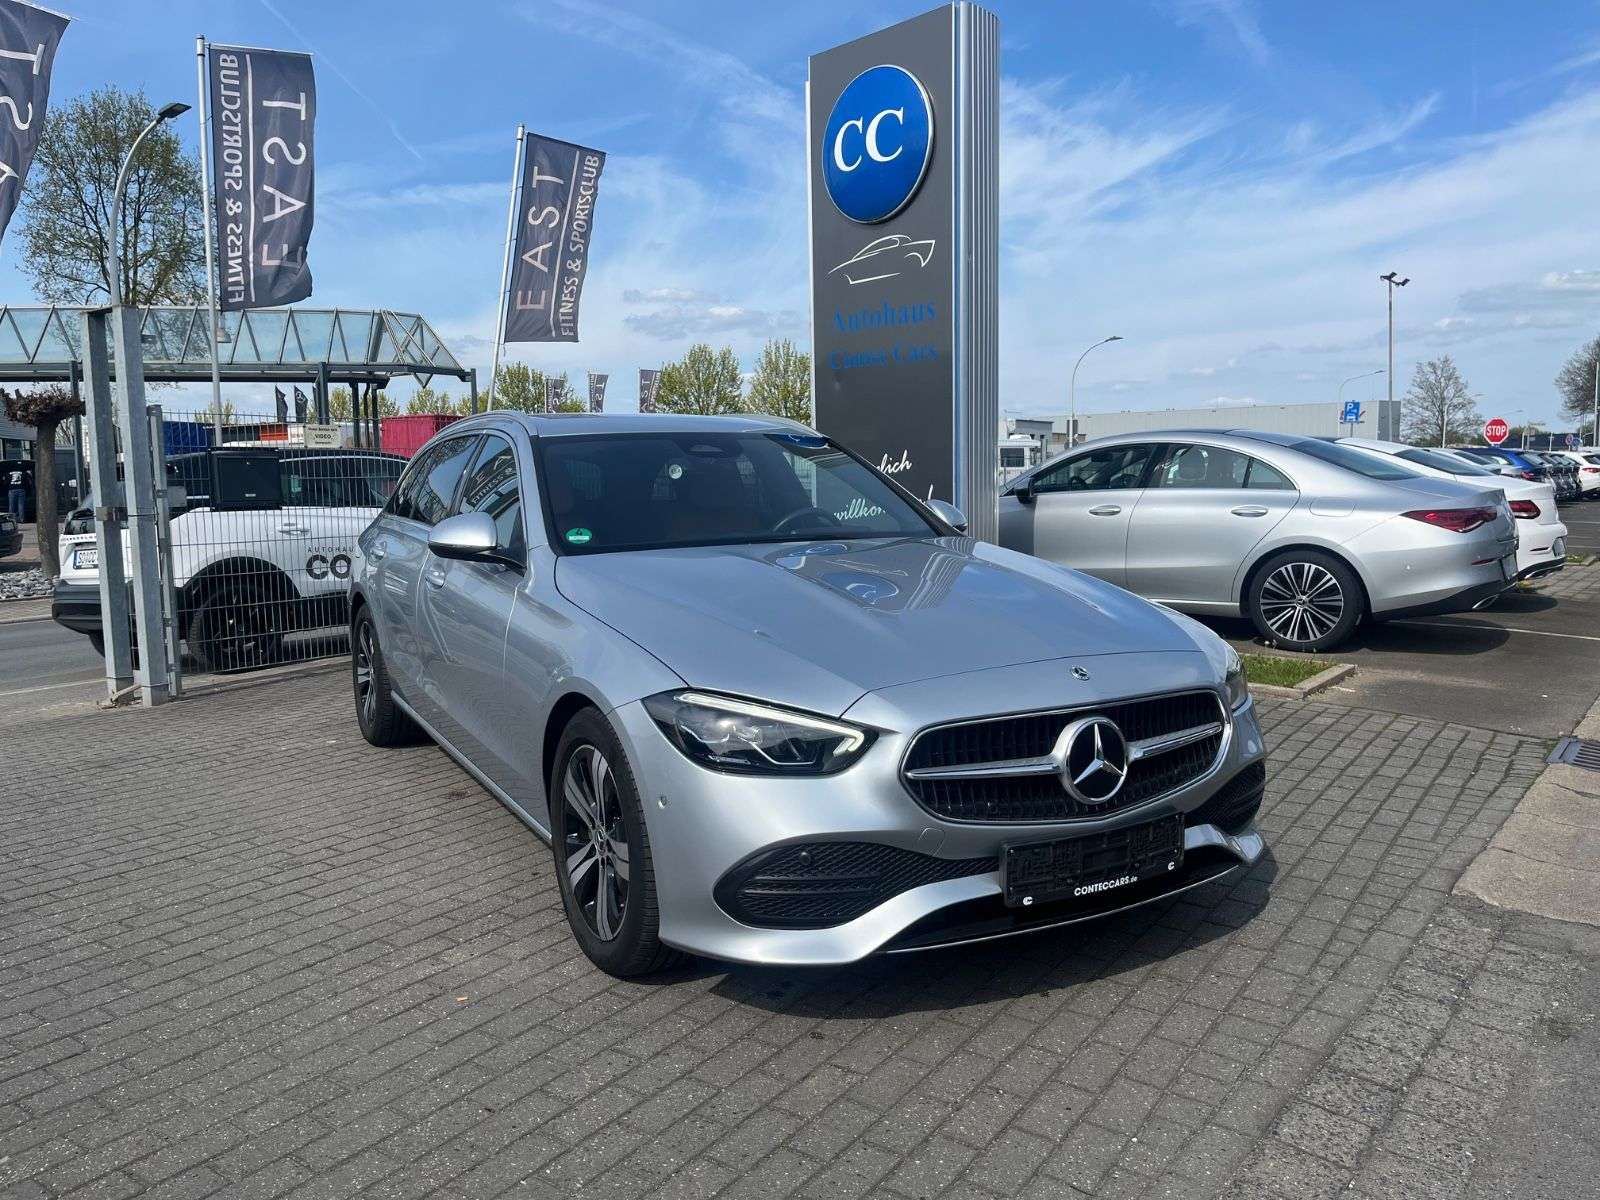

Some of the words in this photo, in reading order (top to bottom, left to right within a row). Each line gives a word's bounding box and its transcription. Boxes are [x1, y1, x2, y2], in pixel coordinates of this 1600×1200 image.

[569, 154, 600, 253] SPORTSCLUB
[515, 165, 565, 311] EAST
[566, 257, 582, 272] &
[559, 275, 579, 337] FITNESS
[1486, 425, 1506, 437] STOP
[876, 449, 912, 474] lich
[1073, 875, 1138, 897] CONTECCARS.de
